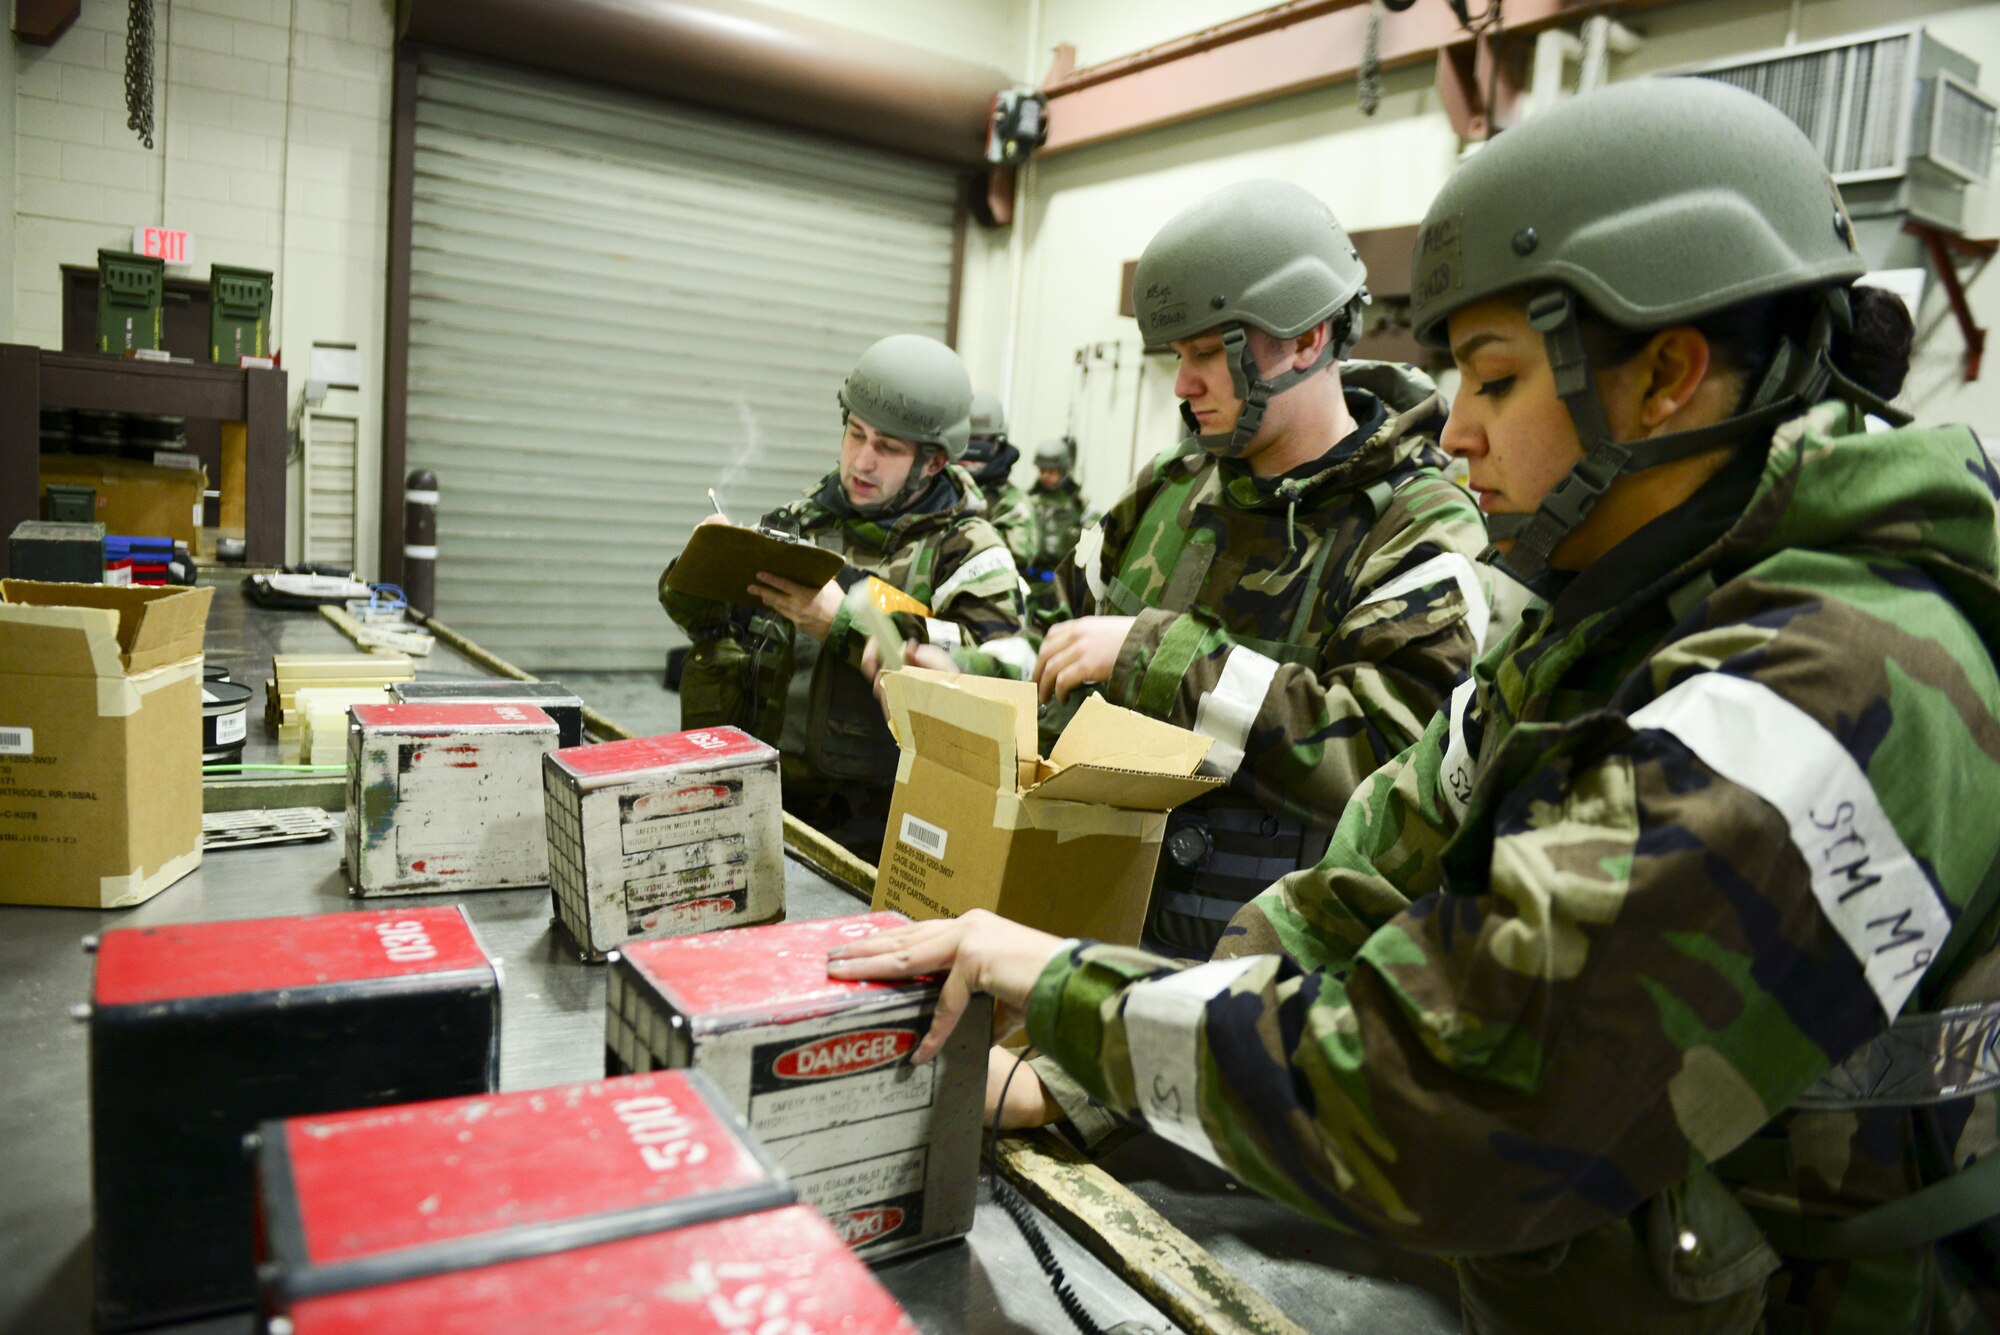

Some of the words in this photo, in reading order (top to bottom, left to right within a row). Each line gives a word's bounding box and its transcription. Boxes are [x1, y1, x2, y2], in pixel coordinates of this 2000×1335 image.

[144, 227, 187, 262] EXIT
[888, 875, 907, 892] CHAFF
[797, 1035, 897, 1075] DANGER
